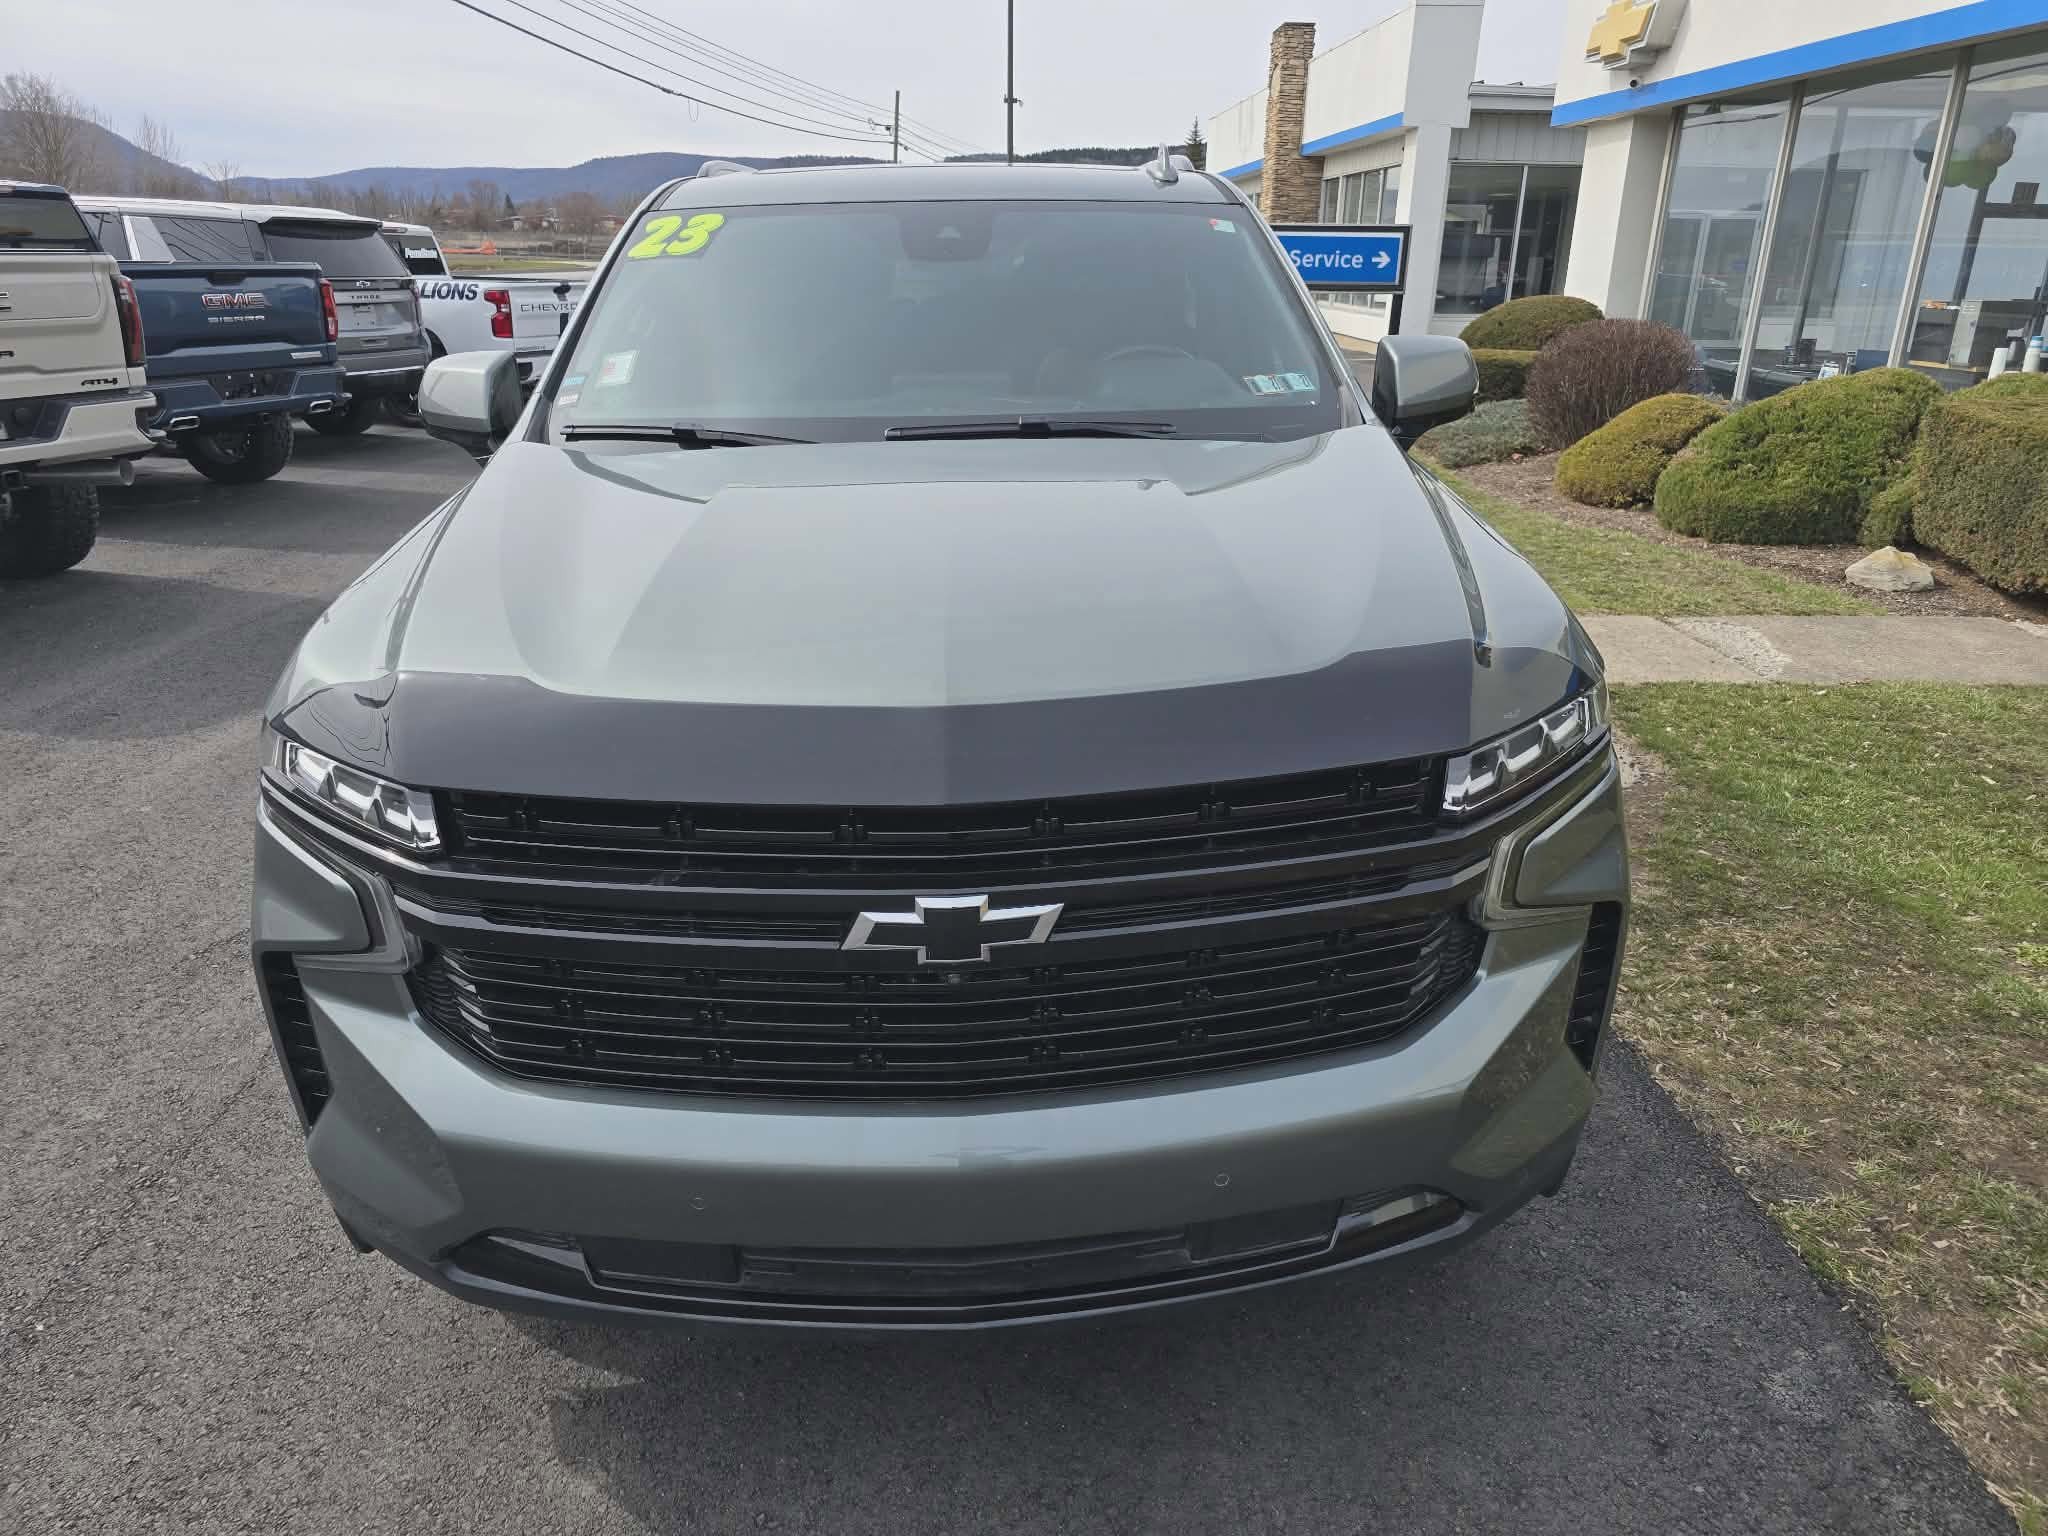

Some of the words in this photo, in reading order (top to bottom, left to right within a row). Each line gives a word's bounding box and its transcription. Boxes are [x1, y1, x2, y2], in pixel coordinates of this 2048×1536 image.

[627, 213, 724, 259] 23
[1290, 249, 1363, 268] Service
[201, 292, 266, 308] GMC
[420, 282, 479, 300] LIONS
[520, 303, 578, 312] CHEVRO
